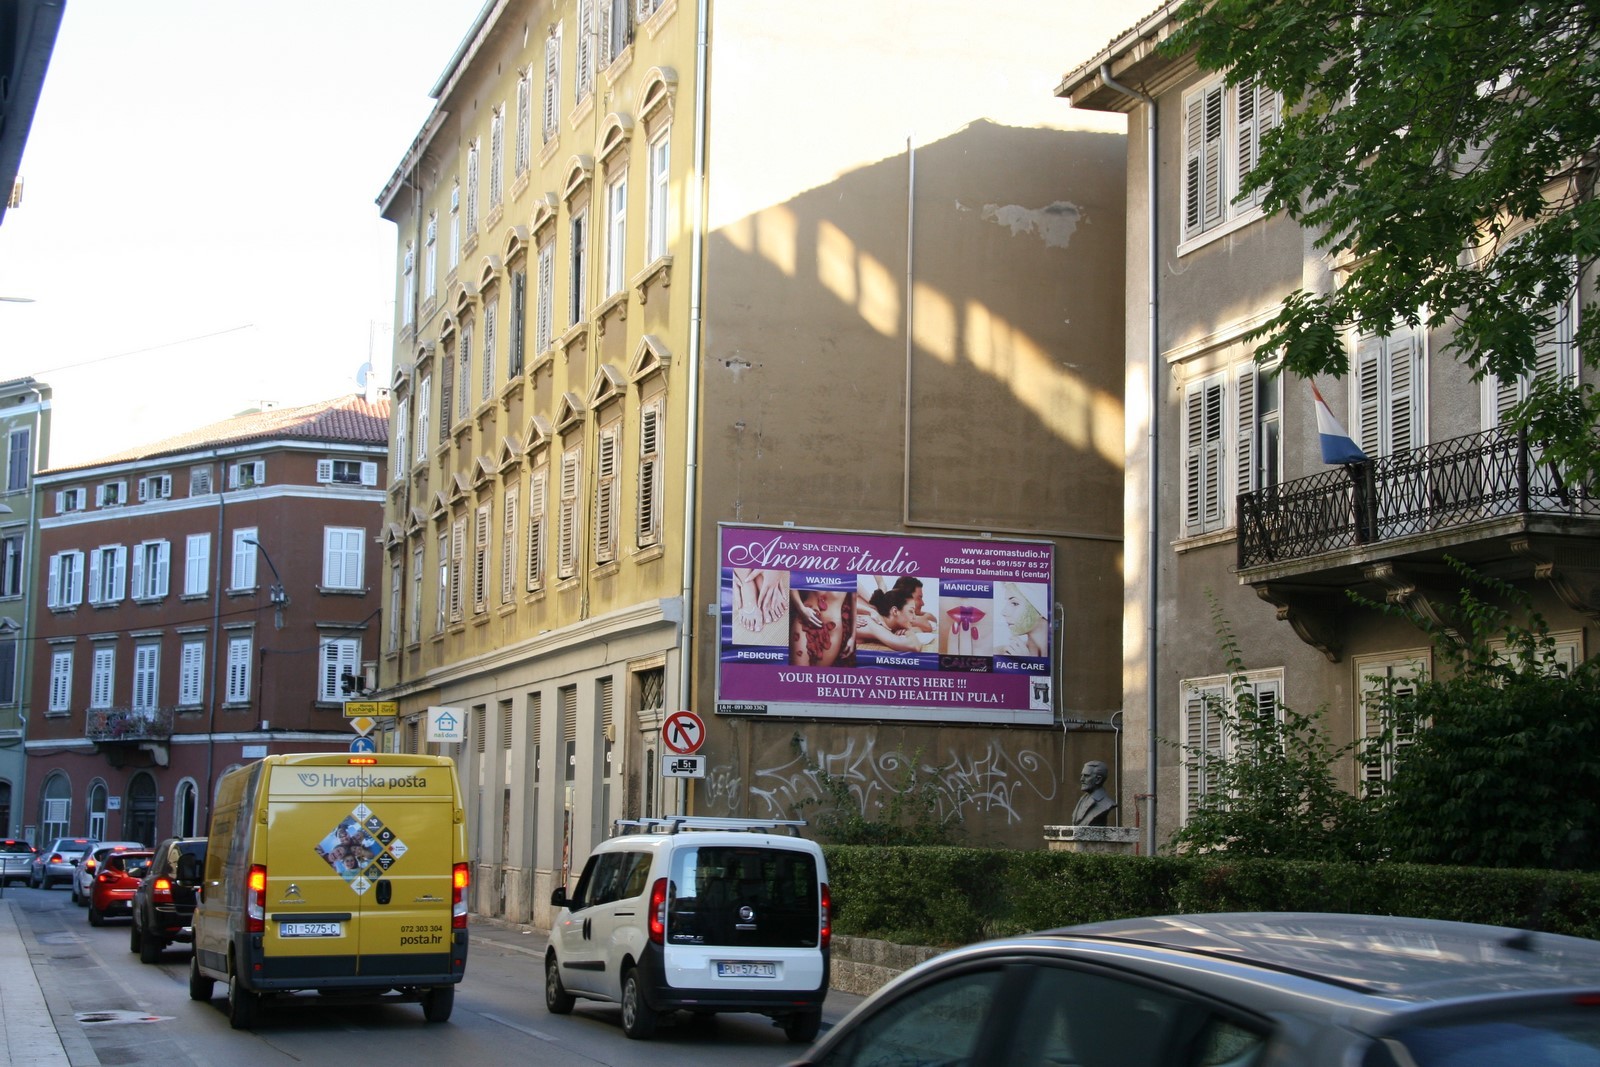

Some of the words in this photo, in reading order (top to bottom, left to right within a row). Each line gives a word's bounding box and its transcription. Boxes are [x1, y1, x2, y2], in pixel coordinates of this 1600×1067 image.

[779, 541, 800, 550] DAY
[802, 543, 820, 552] SPA
[821, 544, 860, 553] CENTAR
[727, 535, 840, 571] Aroma
[846, 546, 920, 574] studio
[961, 548, 1049, 559] www.aromastudio.hr
[944, 557, 975, 565] 052/544
[996, 560, 1026, 568] 091/557
[940, 566, 974, 575] Hermana
[976, 567, 1013, 577] Dalmatina
[1021, 570, 1050, 580] (centar)
[805, 576, 842, 585] WAXING
[943, 583, 990, 592] MANICURE
[737, 651, 784, 660] PEDICURE
[875, 656, 920, 666] MASSAGE
[996, 661, 1019, 670] FACE
[1020, 662, 1045, 671] CARE
[778, 671, 813, 683] YOUR
[816, 673, 873, 686] HOLIDAY
[875, 675, 920, 687] STARTS
[923, 677, 955, 688] HERE
[817, 687, 866, 698] BEAUTY
[868, 689, 897, 699] AND
[900, 690, 948, 702] HEALTH
[950, 692, 965, 702] IN
[967, 692, 998, 703] PULA
[323, 773, 385, 787] Hrvatska
[389, 775, 427, 789] pošta
[400, 925, 414, 933] 072
[400, 934, 442, 946] posta.hr
[724, 964, 736, 974] PU
